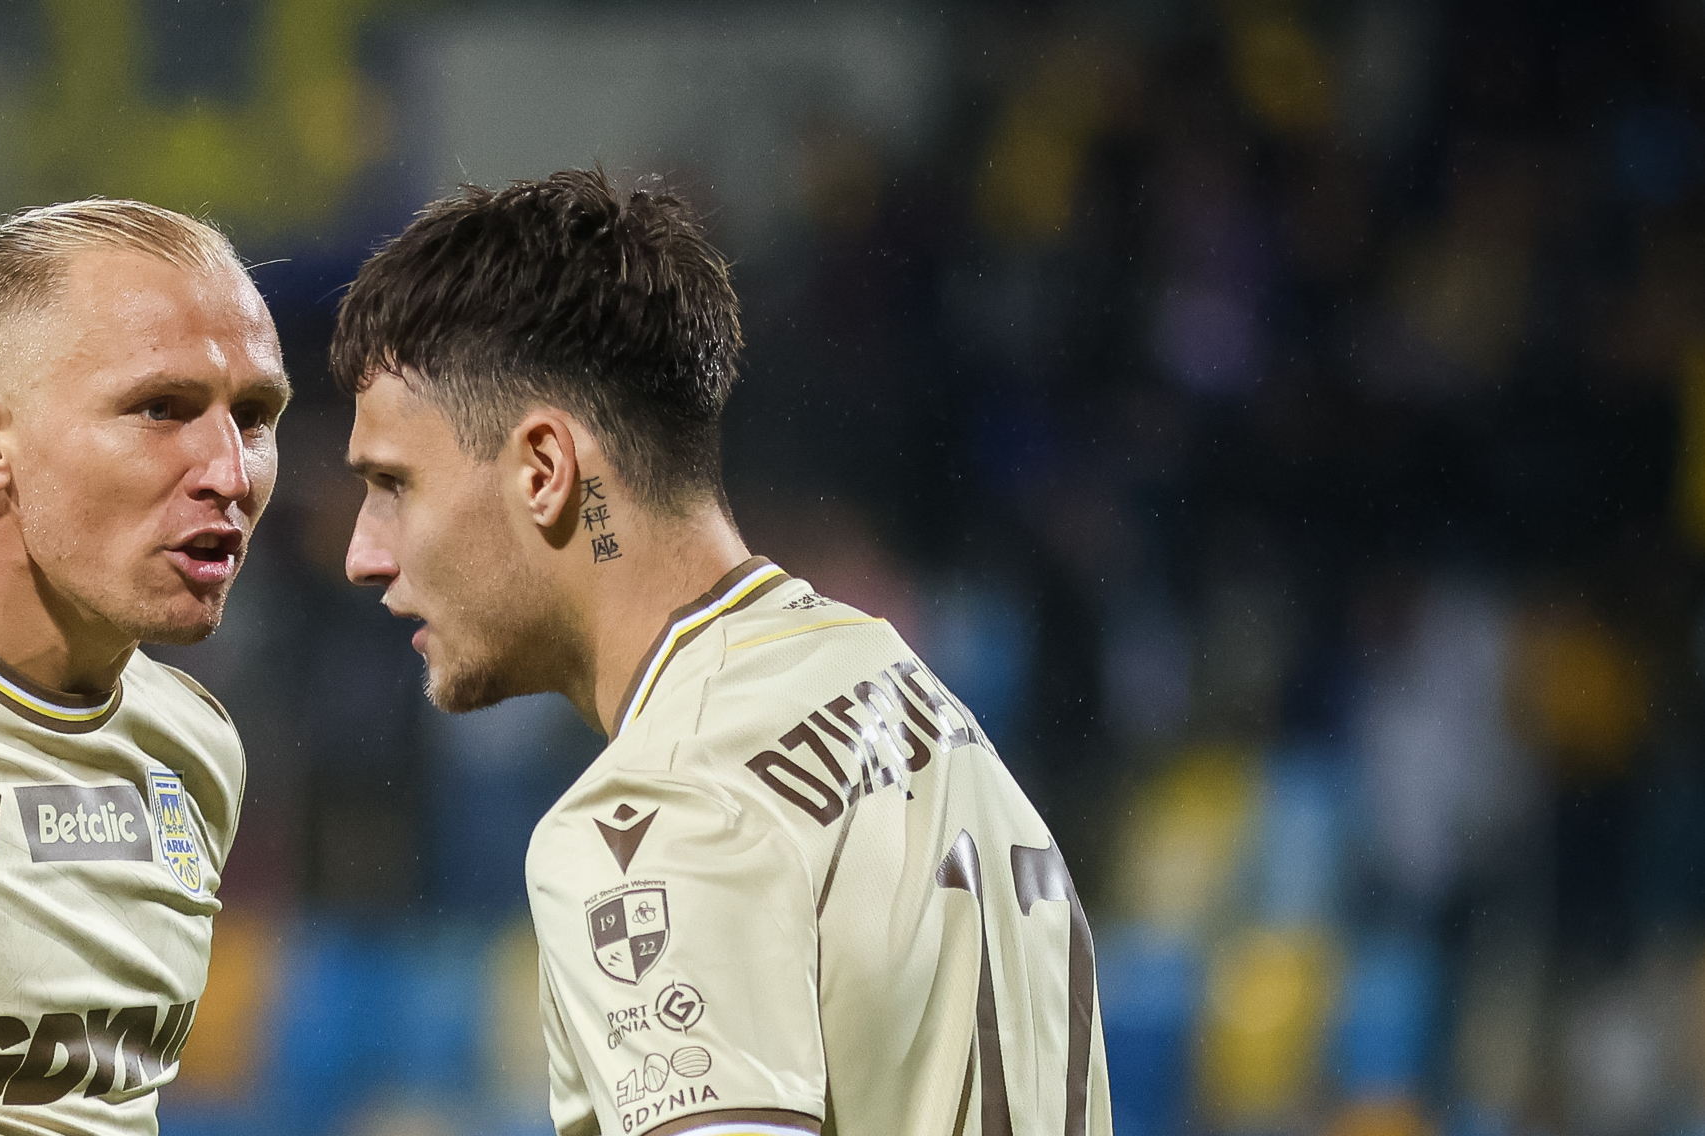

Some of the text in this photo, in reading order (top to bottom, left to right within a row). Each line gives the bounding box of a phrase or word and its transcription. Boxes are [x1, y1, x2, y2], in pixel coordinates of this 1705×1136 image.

[38, 801, 138, 845] Betclic
[167, 840, 193, 853] ARKA
[600, 914, 616, 932] 19
[639, 941, 657, 957] 22
[607, 1005, 649, 1029] PORT
[622, 1085, 720, 1134] GDYNIA
